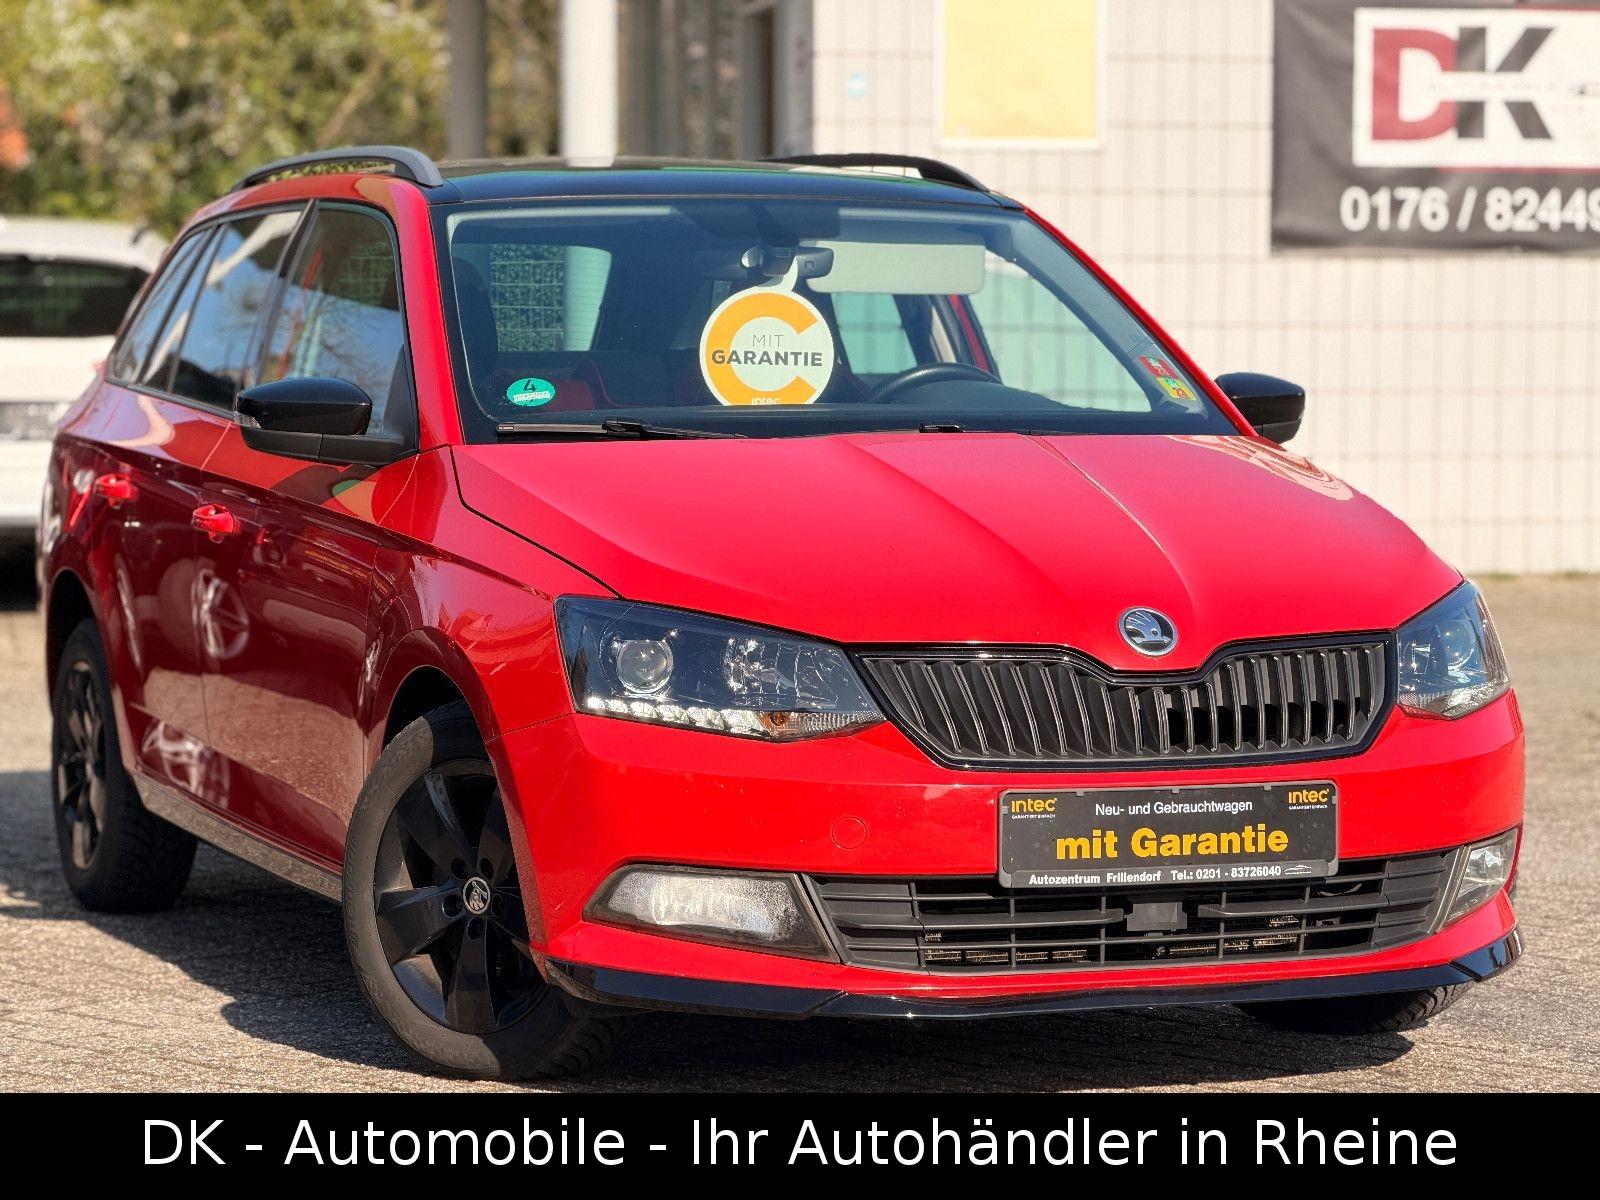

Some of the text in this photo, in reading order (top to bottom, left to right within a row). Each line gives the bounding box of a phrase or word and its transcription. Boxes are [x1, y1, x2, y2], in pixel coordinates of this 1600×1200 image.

[1371, 26, 1555, 141] DK
[1339, 186, 1450, 232] 0176
[1456, 185, 1478, 232] /
[752, 333, 784, 348] MIT
[711, 349, 823, 367] GARANTIE
[523, 379, 538, 392] 4
[1288, 789, 1330, 804] intec
[1011, 798, 1057, 813] intec
[1095, 800, 1253, 816] Neu- und Gebrauchtwagen
[1056, 823, 1289, 860] mit Garantie
[1028, 874, 1101, 885] Autozentrum
[1106, 870, 1162, 883] Frillendorf
[1170, 869, 1193, 881] Tel.:
[1195, 868, 1221, 880] 0201
[1231, 866, 1282, 878] 83726040
